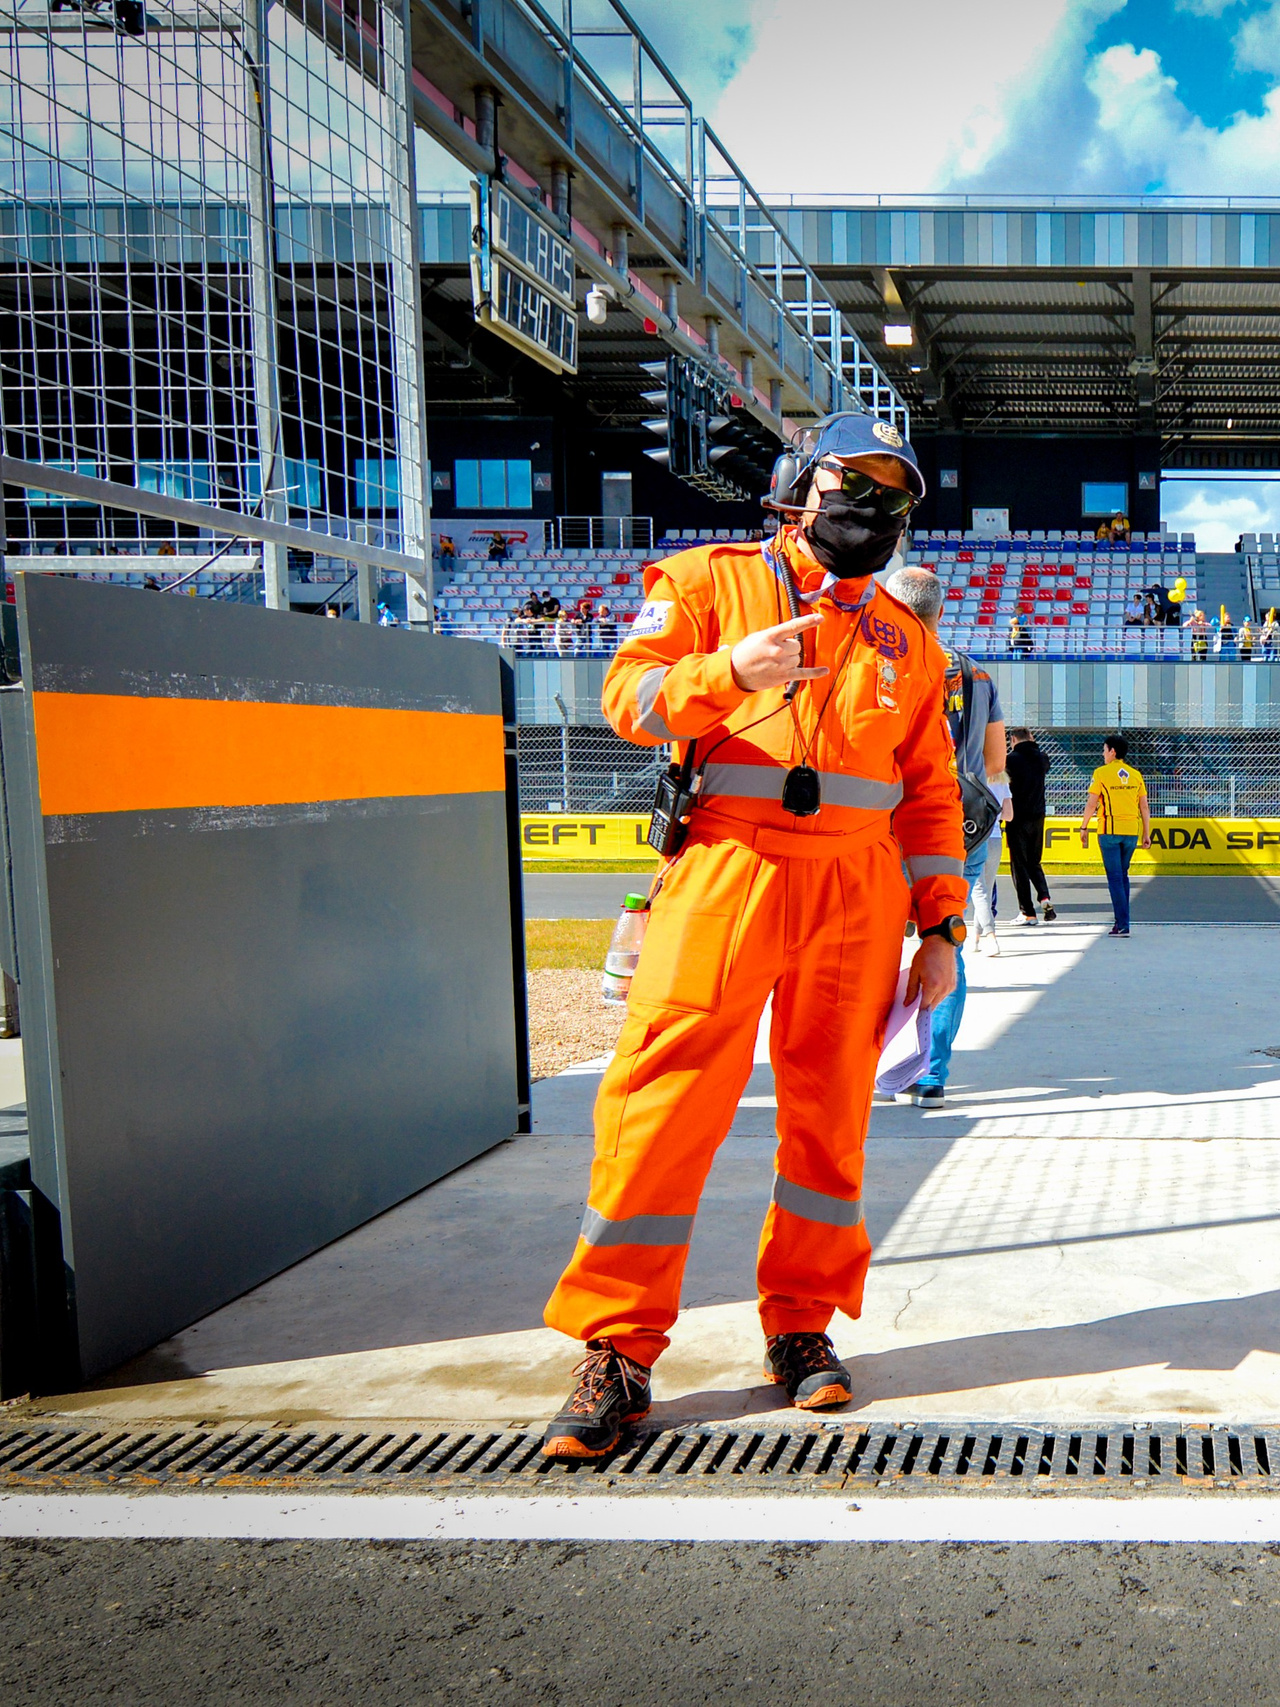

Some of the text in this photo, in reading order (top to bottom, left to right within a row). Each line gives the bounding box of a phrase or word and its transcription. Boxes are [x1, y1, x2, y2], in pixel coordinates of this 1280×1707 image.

[525, 216, 573, 301] LAPS
[535, 476, 550, 487] A5
[941, 473, 957, 485] A5
